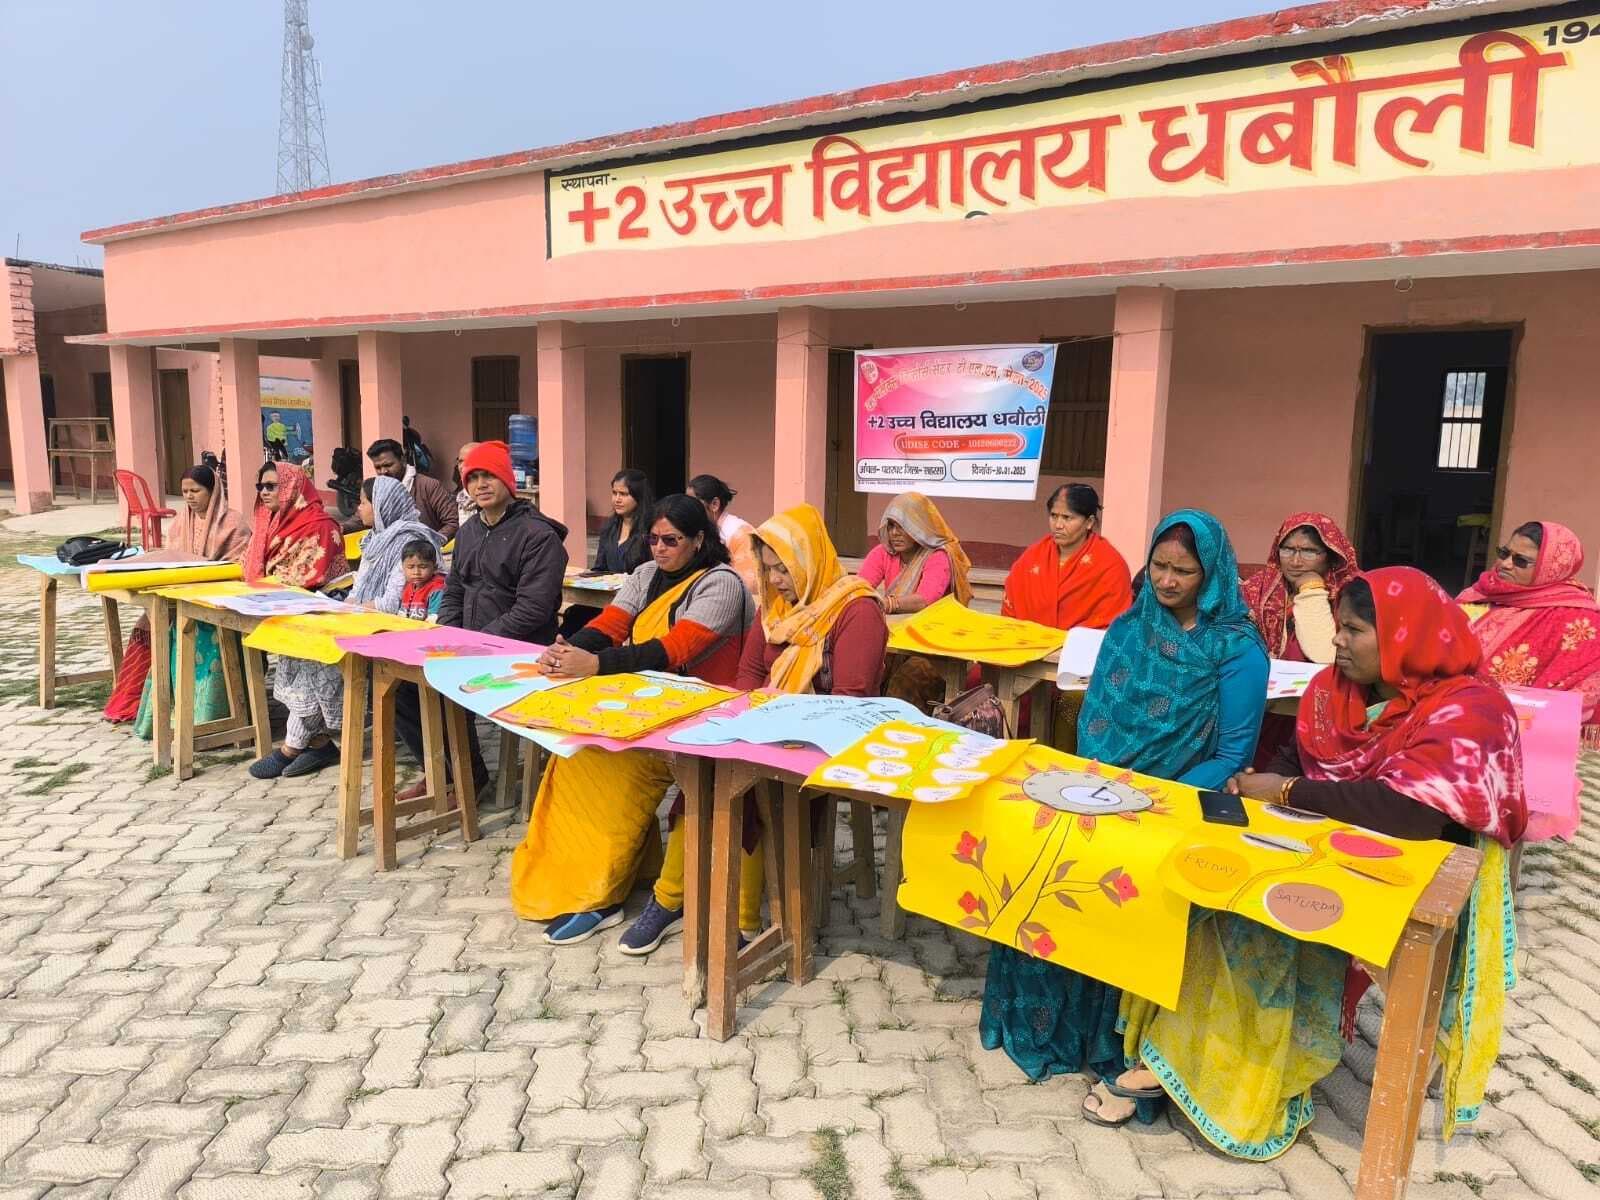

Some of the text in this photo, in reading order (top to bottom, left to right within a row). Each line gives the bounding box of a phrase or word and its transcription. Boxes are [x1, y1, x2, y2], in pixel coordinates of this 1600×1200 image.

[567, 30, 1567, 243] +2 उच्च विद्यालय धबौली
[868, 415, 885, 429] +2
[887, 416, 916, 429] उच्च
[920, 410, 987, 431] विद्यालय
[901, 439, 929, 449] UDISE
[931, 439, 960, 449] CODE
[1184, 853, 1239, 878] FRIDAY
[1276, 889, 1342, 915] SATURDAY
